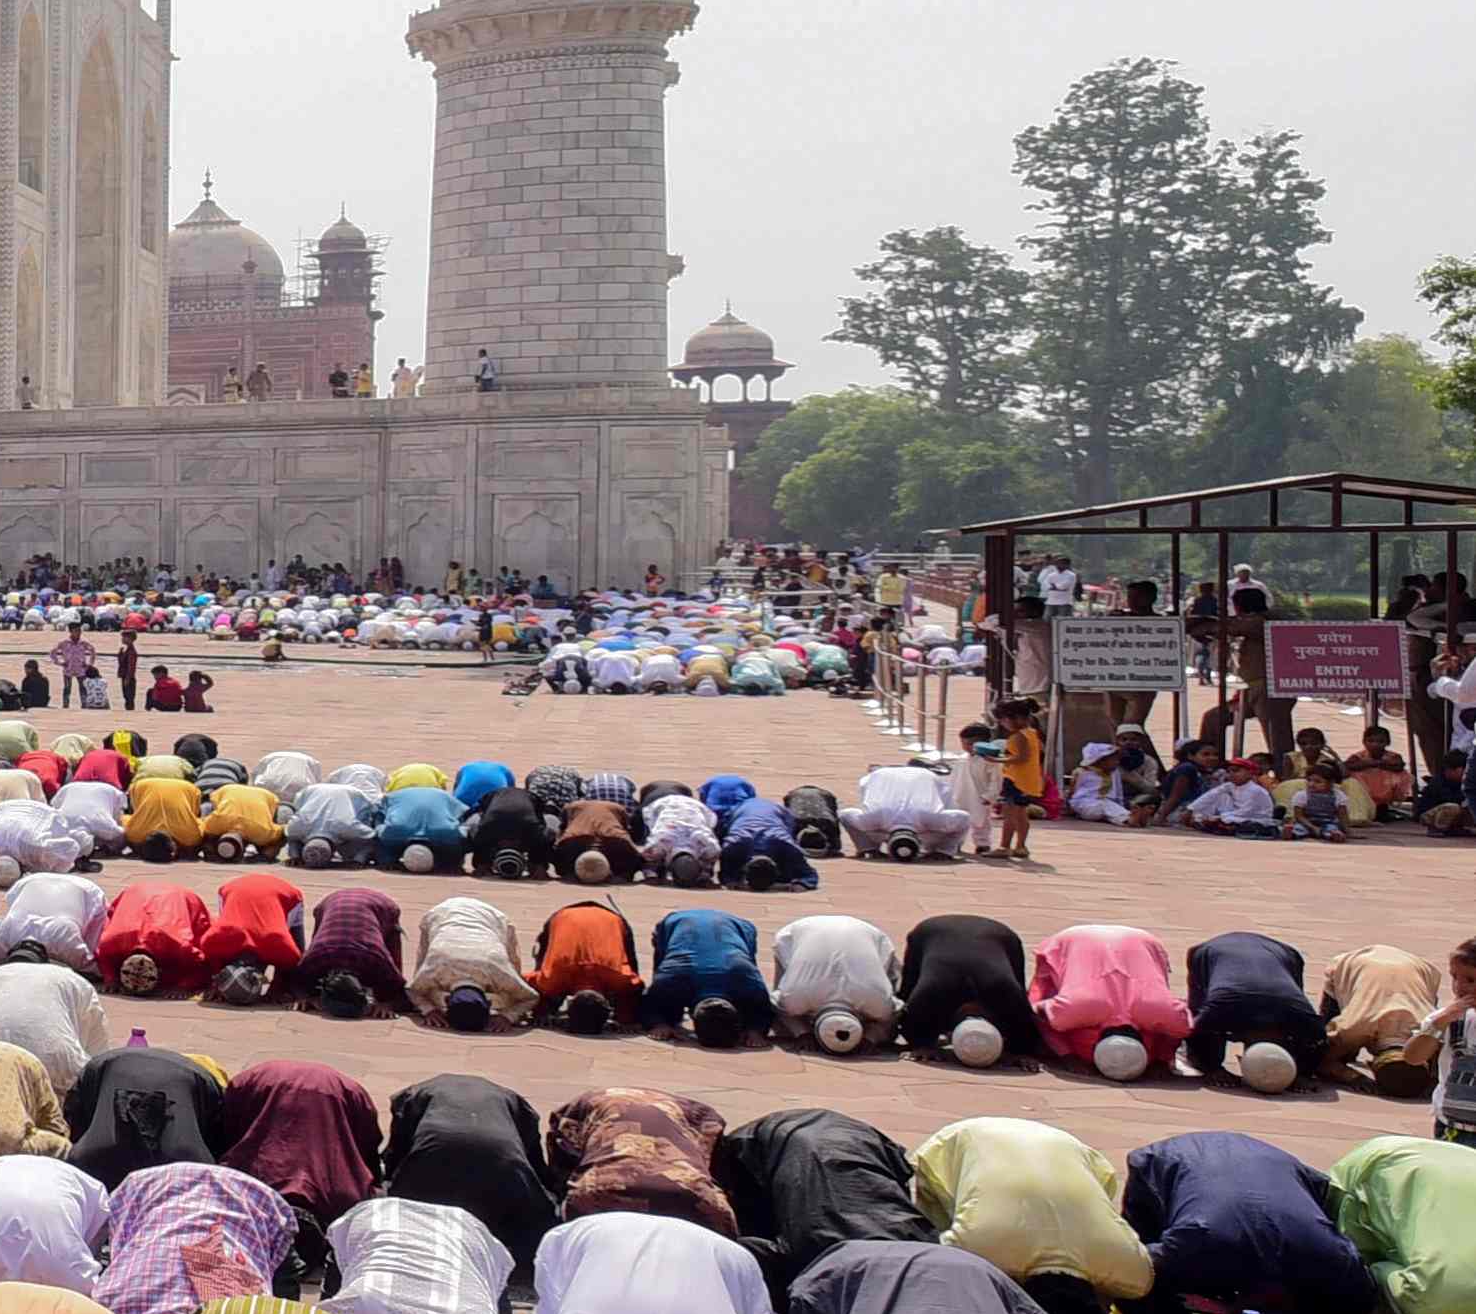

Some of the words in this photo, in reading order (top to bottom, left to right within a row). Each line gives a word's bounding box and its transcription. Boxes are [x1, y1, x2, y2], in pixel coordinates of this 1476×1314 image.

[1315, 666, 1360, 676] ENTRY
[1279, 678, 1314, 688] MAIN
[1317, 678, 1399, 689] MAUSOLIUM
